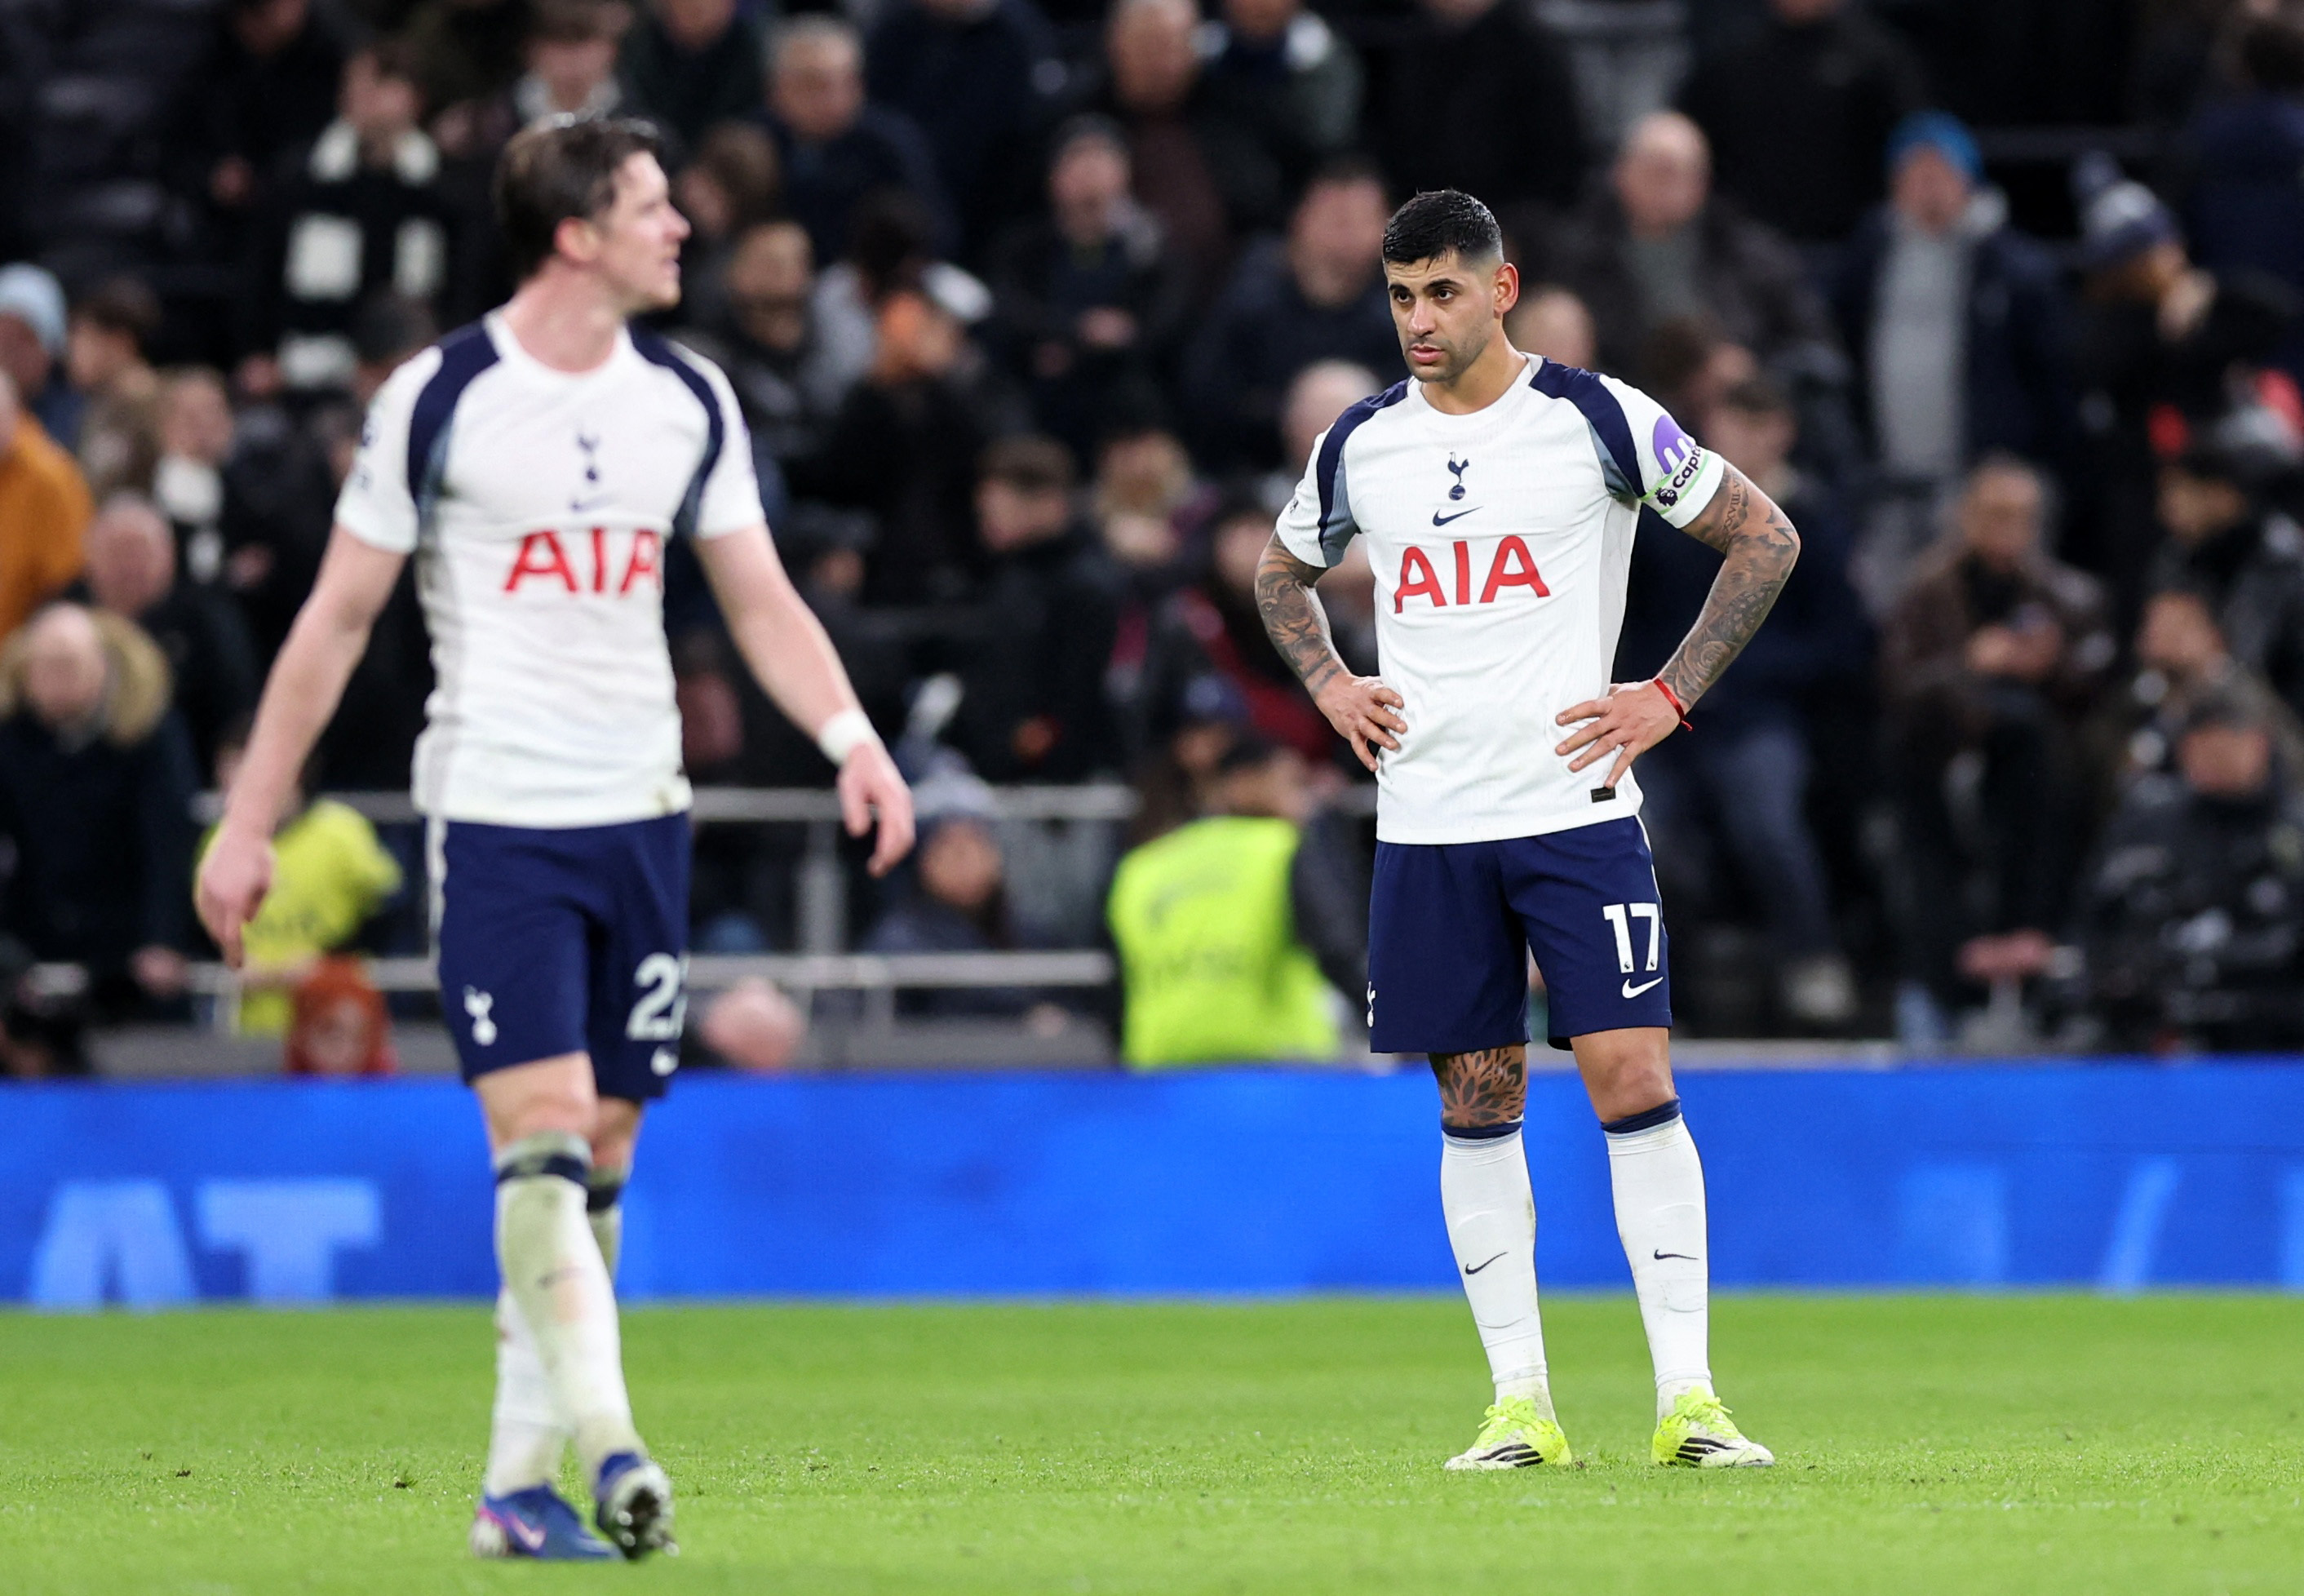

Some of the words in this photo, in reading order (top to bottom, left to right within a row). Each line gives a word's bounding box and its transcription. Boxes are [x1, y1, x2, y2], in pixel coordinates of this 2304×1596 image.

[1673, 446, 1700, 488] Capt
[503, 527, 662, 596] AIA
[1393, 534, 1551, 614] AIA
[1602, 902, 1659, 973] 17
